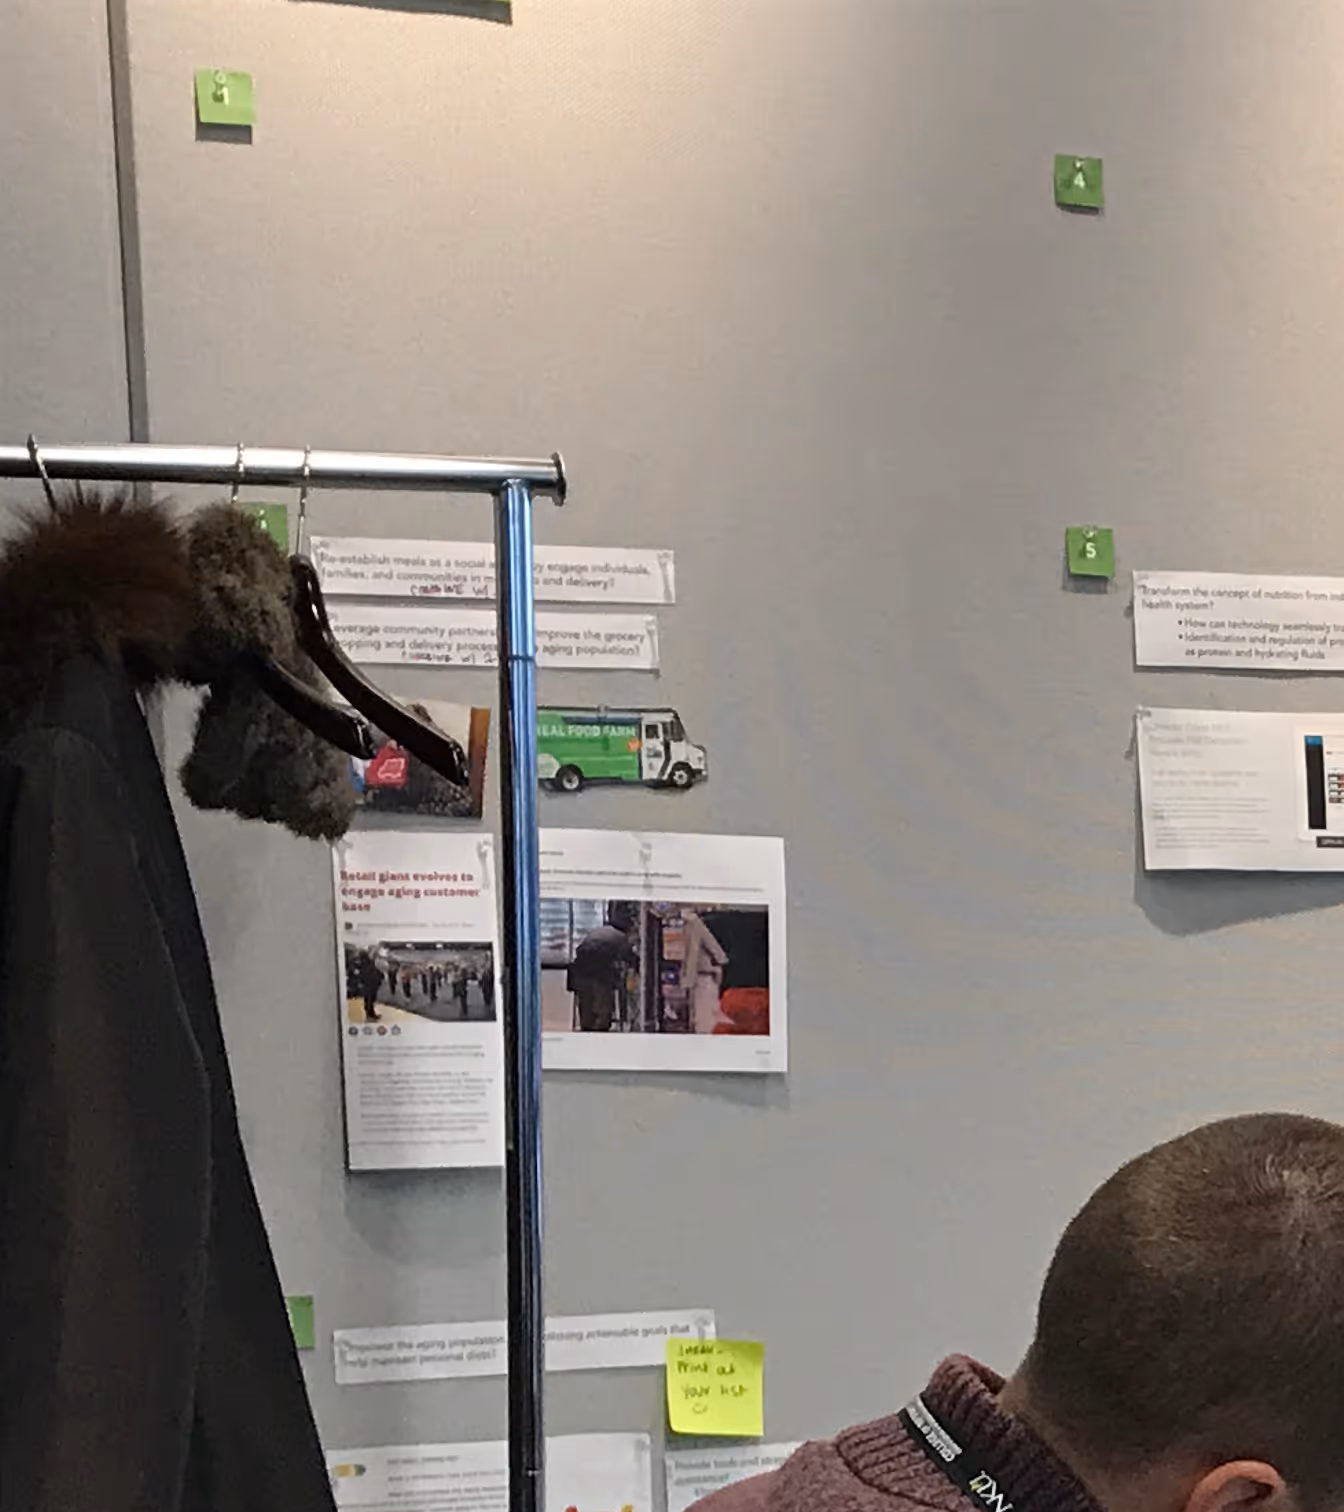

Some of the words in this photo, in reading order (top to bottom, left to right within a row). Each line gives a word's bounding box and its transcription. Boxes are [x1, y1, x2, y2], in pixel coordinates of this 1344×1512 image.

[1073, 173, 1084, 188] 4
[1085, 543, 1096, 558] 5
[320, 553, 390, 565] Re-establish
[394, 556, 425, 567] meals
[429, 558, 441, 567] as
[445, 559, 450, 567] a
[454, 558, 485, 568] social
[548, 565, 588, 576] engage
[591, 564, 650, 575] individuals,
[322, 570, 369, 582] families,
[371, 570, 393, 580] and
[397, 572, 467, 583] communities
[472, 574, 482, 583] in
[544, 577, 562, 587] and
[566, 576, 614, 590] delivery?
[1141, 586, 1190, 597] Transform
[1193, 587, 1209, 597] the
[1211, 589, 1250, 600] concept
[1252, 589, 1262, 598] of
[1264, 590, 1303, 600] nutrition
[1305, 591, 1327, 601] from
[1142, 599, 1173, 610] health
[1175, 600, 1214, 612] system?
[1184, 618, 1207, 629] How
[1209, 620, 1225, 630] can
[1228, 619, 1280, 633] technology
[1282, 621, 1331, 634] seamlessly
[333, 625, 380, 636] everage
[383, 624, 445, 637] community
[583, 630, 600, 641] the
[604, 632, 645, 644] grocery
[1185, 633, 1247, 644] Identification
[1249, 634, 1266, 645] and
[1269, 635, 1316, 647] regulation
[1318, 636, 1327, 646] of
[385, 639, 405, 650] and
[409, 639, 453, 652] delivery
[543, 645, 573, 656] aging
[576, 644, 640, 656] population?
[1185, 649, 1195, 658] as
[1197, 648, 1232, 660] protein
[1234, 648, 1252, 658] and
[1255, 648, 1299, 661] hydrating
[1301, 650, 1325, 661] fluids
[567, 725, 600, 738] FOOD
[604, 725, 636, 738] FARM
[340, 870, 375, 883] Retail
[378, 871, 410, 886] giant
[413, 871, 457, 883] evolves
[461, 872, 474, 882] to
[341, 887, 383, 901] engage
[386, 887, 421, 901] aging
[423, 887, 480, 898] customer
[341, 901, 371, 913] base
